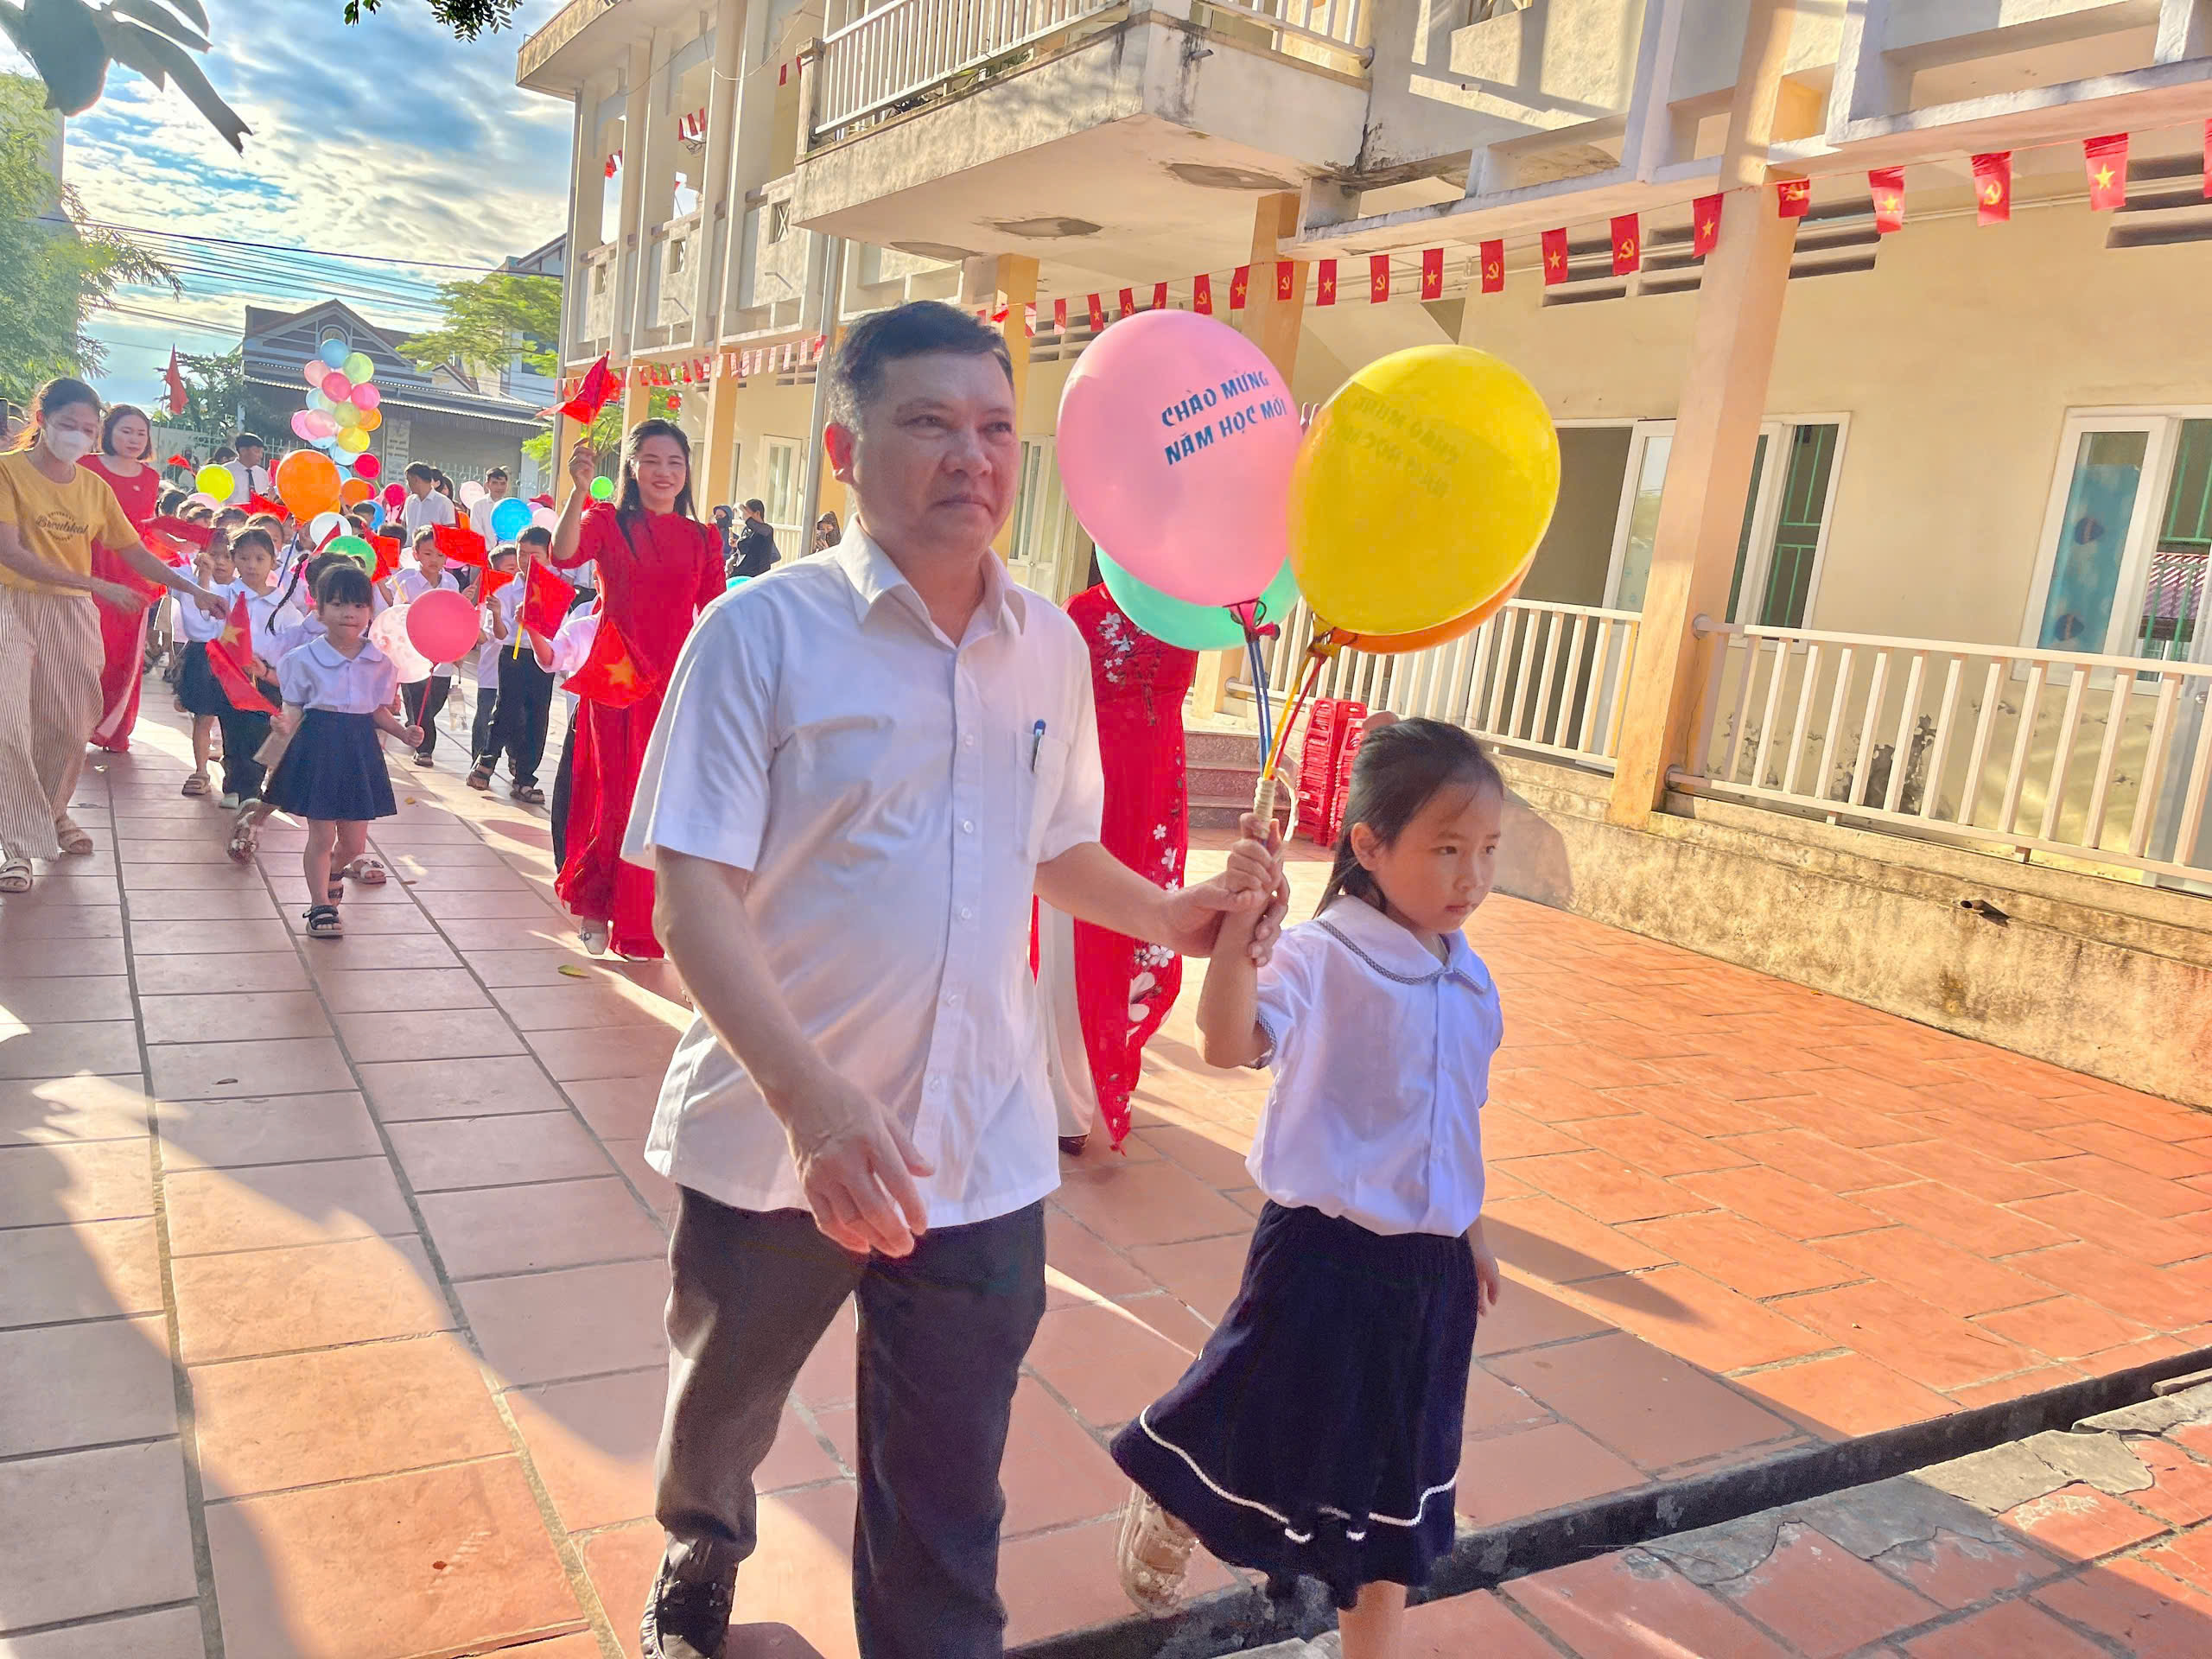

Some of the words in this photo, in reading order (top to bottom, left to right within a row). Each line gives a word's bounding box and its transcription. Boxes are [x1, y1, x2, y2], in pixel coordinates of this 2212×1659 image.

[1161, 388, 1217, 427] CHÀO
[1220, 369, 1269, 399] MỪNG
[1165, 425, 1214, 465] NĂM
[1218, 404, 1257, 438] HỌC
[1260, 394, 1287, 419] MỚI
